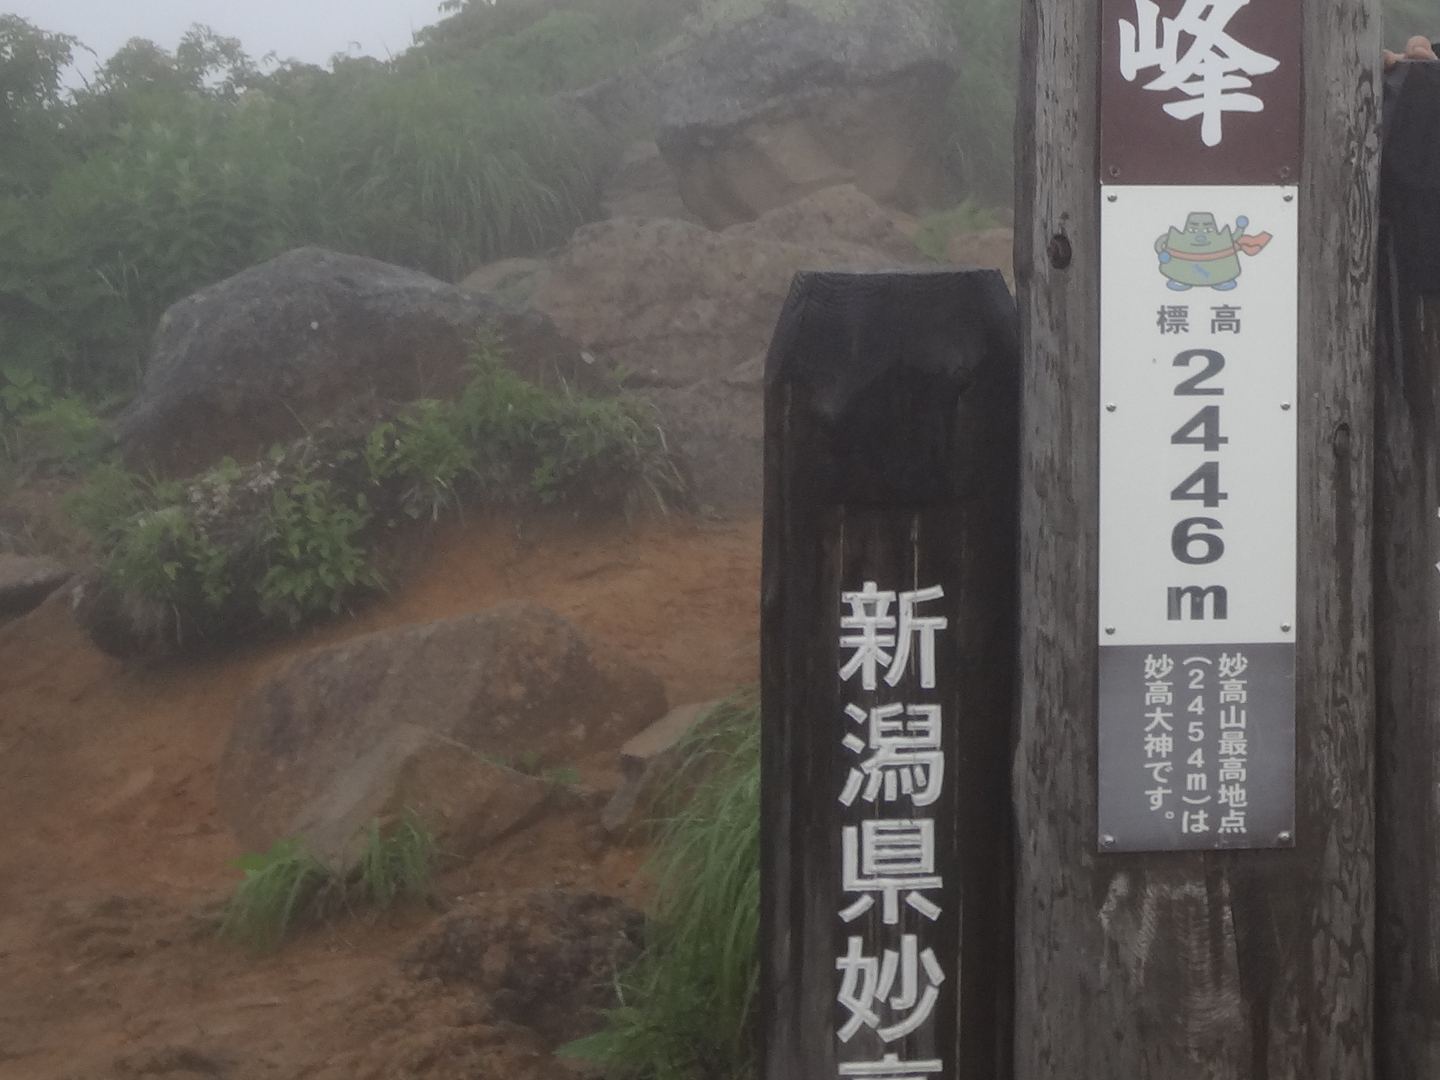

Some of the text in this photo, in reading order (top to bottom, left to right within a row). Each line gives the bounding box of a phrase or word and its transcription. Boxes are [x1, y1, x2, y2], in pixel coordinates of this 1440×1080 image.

[1156, 304, 1243, 335] 標高
[1166, 348, 1230, 621] 2446m
[1144, 654, 1174, 819] 妙高大神です。
[1218, 653, 1248, 834] 妙高山最高地点
[836, 581, 948, 1080] 新潟県妙
